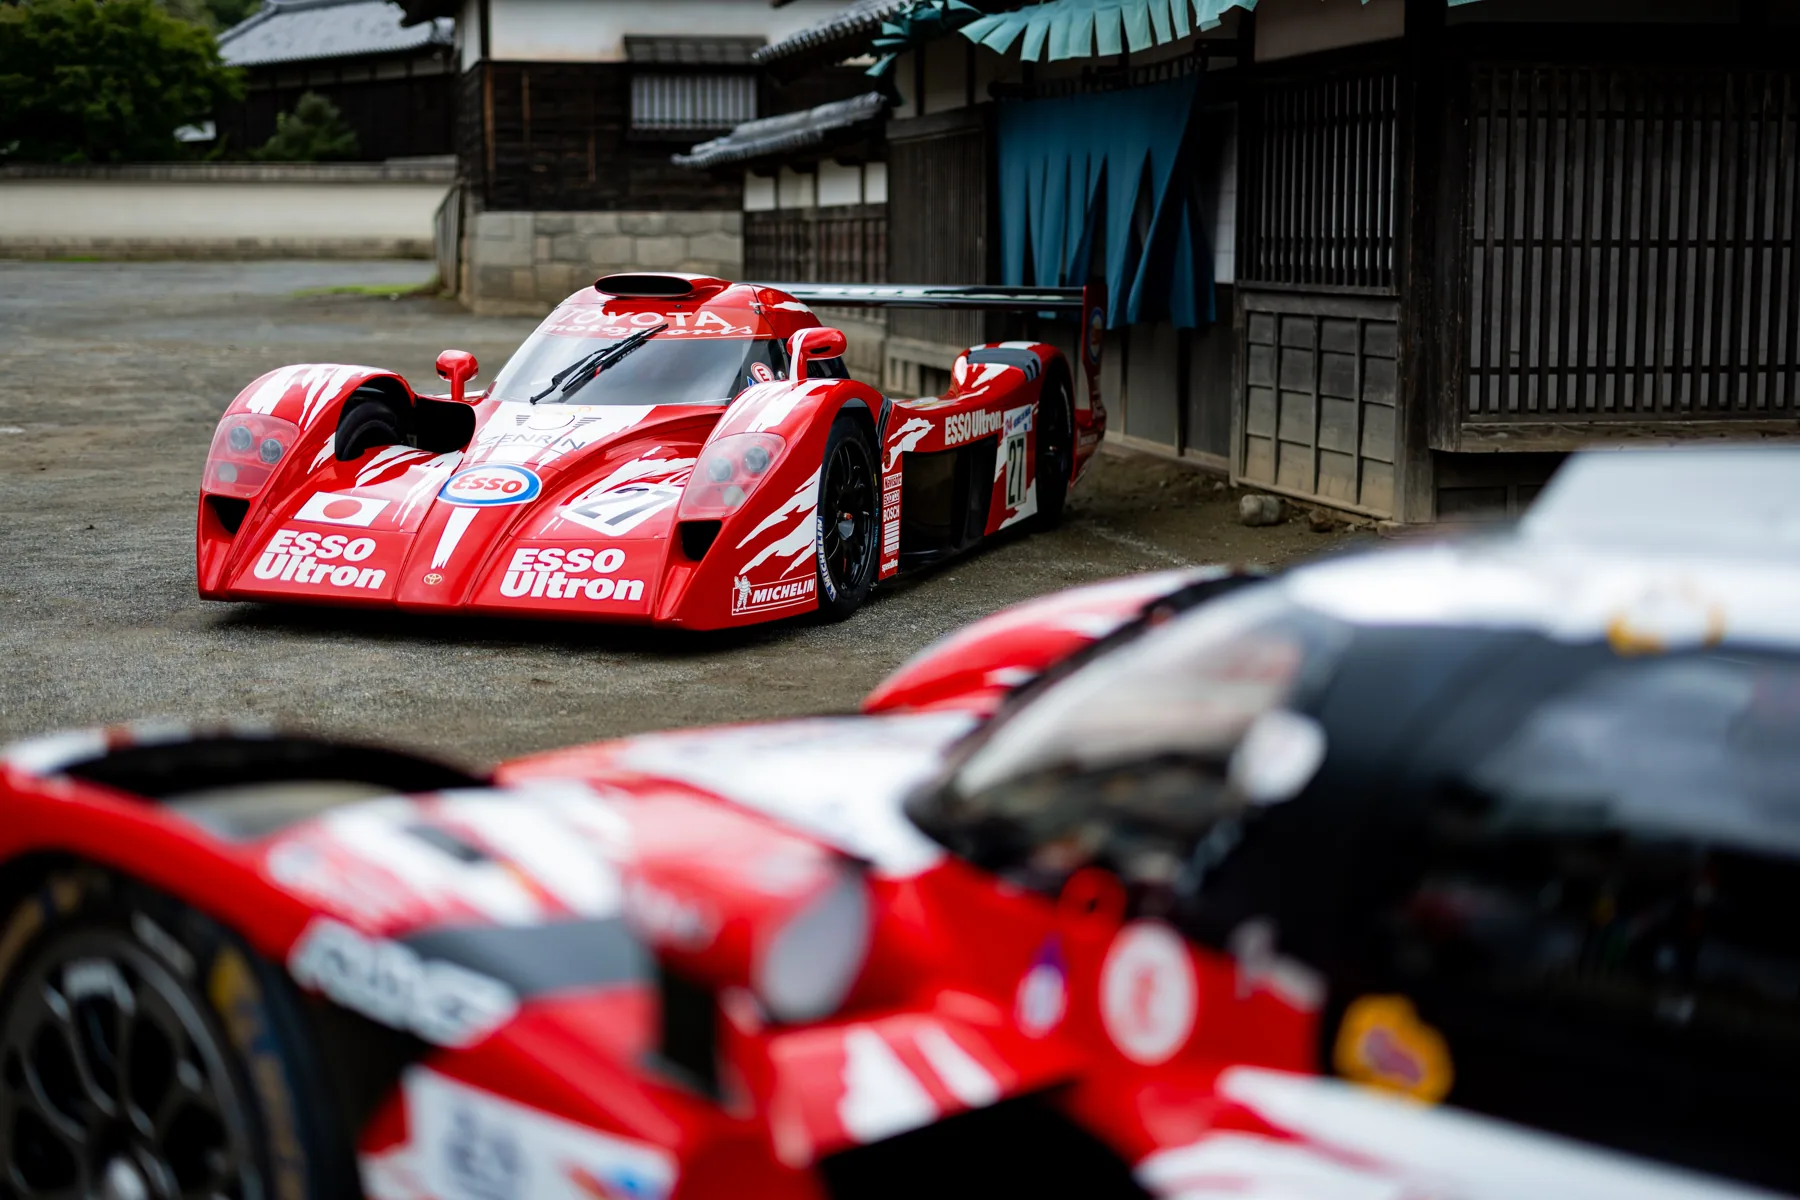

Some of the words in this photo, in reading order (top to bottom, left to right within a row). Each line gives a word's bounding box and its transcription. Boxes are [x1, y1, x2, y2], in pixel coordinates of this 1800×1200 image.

[557, 307, 728, 328] TOYOTA
[479, 432, 587, 450] ZENRIN
[945, 411, 971, 446] ESSO
[972, 408, 1002, 438] Ultron
[1008, 437, 1025, 506] 27
[571, 486, 681, 526] 27
[883, 505, 900, 522] BOSCH
[265, 529, 376, 562] ESSO
[509, 548, 627, 574] ESSO
[254, 552, 387, 589] Ultron
[500, 570, 645, 601] Ultron
[752, 578, 815, 604] MICHELIN
